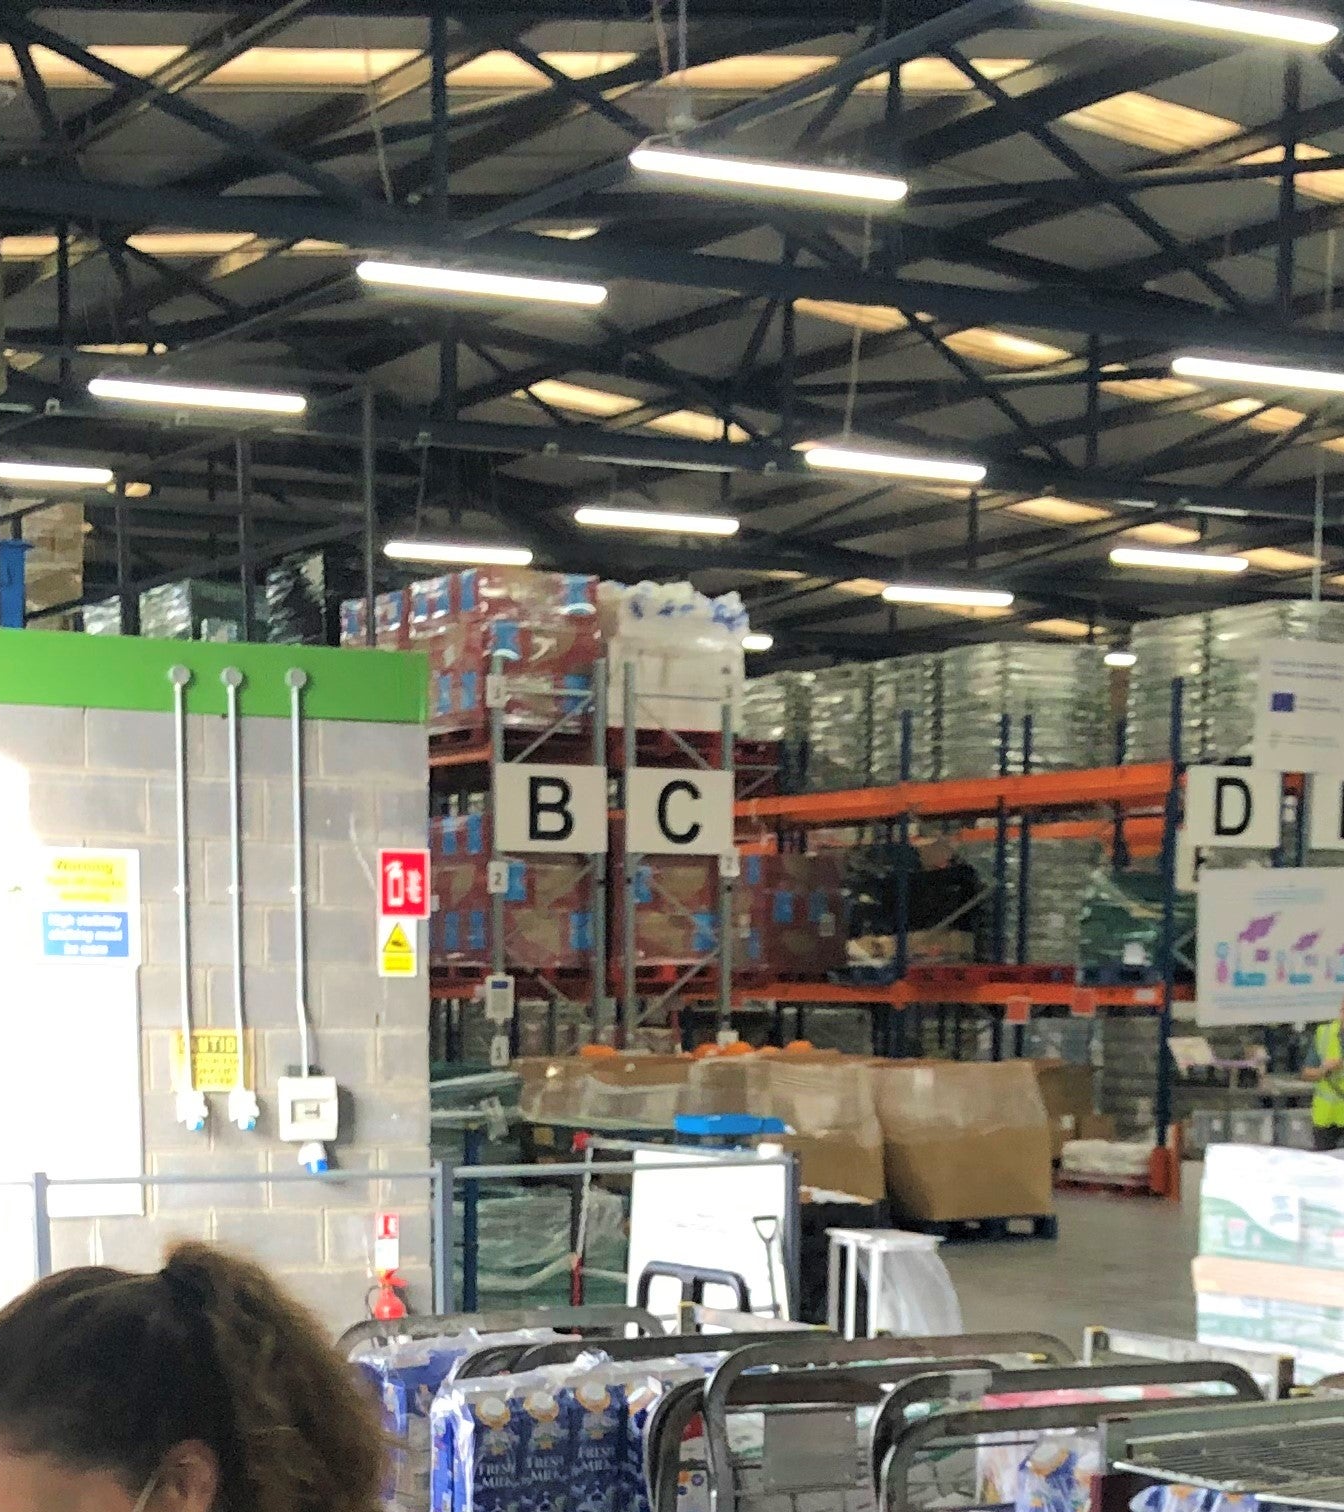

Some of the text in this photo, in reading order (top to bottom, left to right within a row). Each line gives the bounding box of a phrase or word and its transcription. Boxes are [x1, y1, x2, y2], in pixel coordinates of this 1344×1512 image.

[529, 775, 573, 841] B
[657, 779, 702, 844] C
[1215, 777, 1252, 836] D
[494, 872, 502, 886] 2
